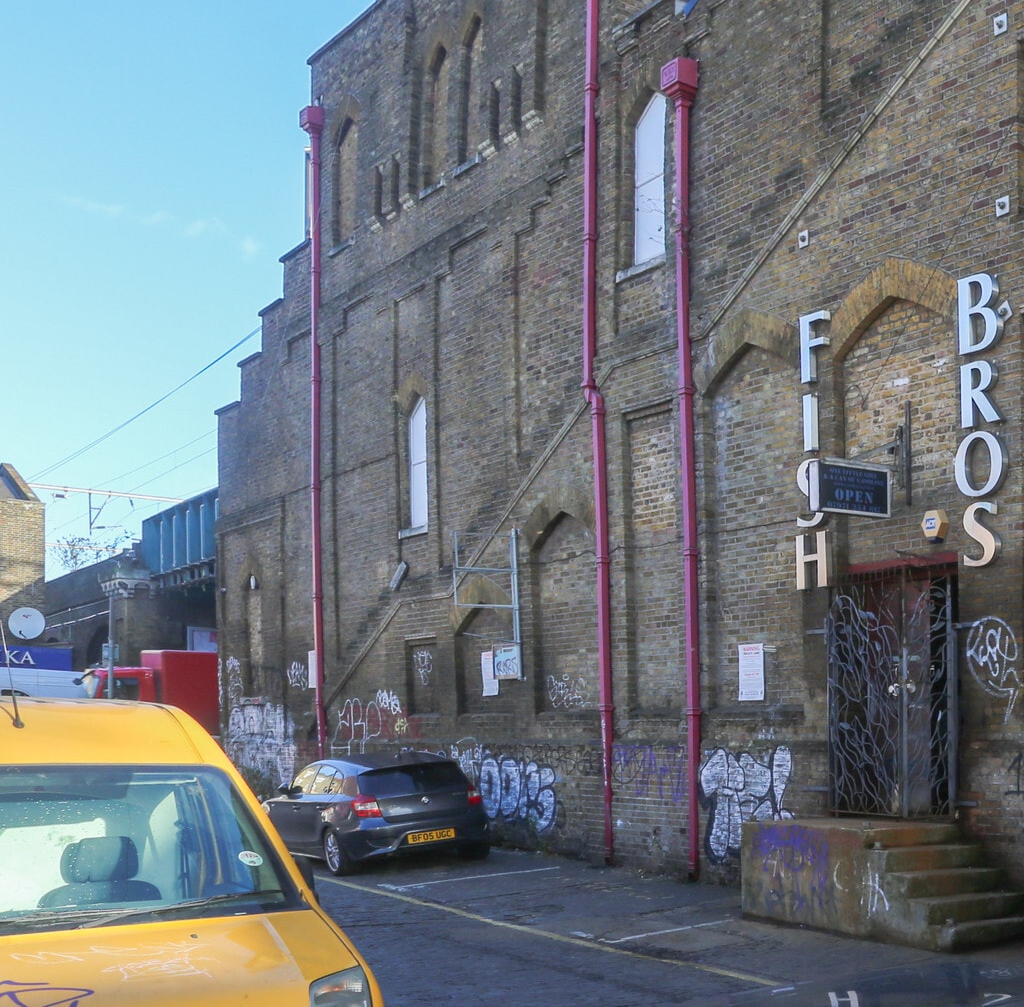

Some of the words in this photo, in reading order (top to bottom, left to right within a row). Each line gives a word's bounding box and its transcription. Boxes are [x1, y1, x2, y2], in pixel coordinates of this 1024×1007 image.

[955, 273, 1006, 568] BROS
[834, 488, 874, 504] OPEN
[0, 650, 36, 665] KA
[412, 832, 434, 843] BF05
[435, 830, 453, 839] UGC
